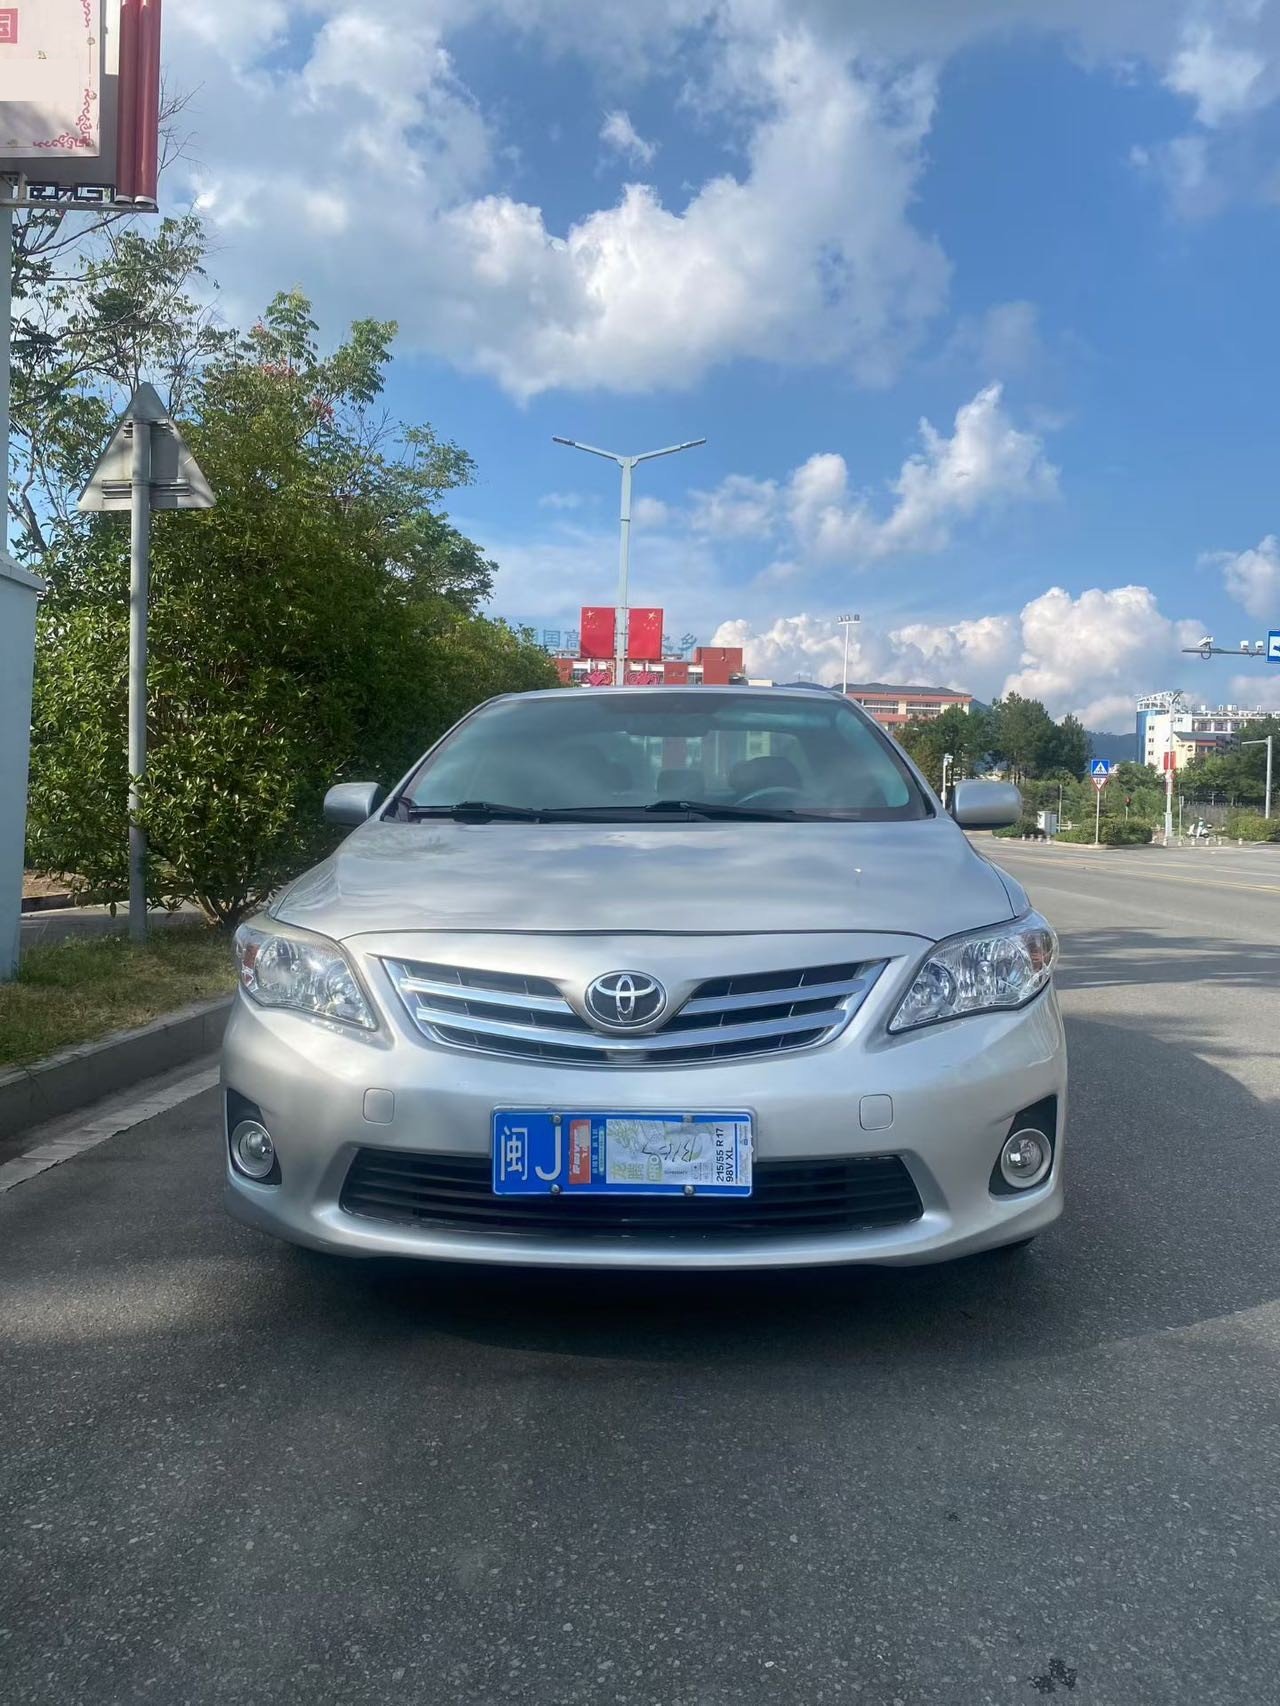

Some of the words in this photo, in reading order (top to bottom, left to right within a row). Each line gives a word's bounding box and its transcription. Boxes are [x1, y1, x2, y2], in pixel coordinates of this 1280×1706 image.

[715, 1127, 724, 1138] 17
[716, 1139, 724, 1147] R
[725, 1147, 734, 1161] XL
[649, 1155, 660, 1181] PRO
[716, 1149, 725, 1182] 215/55
[726, 1162, 734, 1183] 98V
